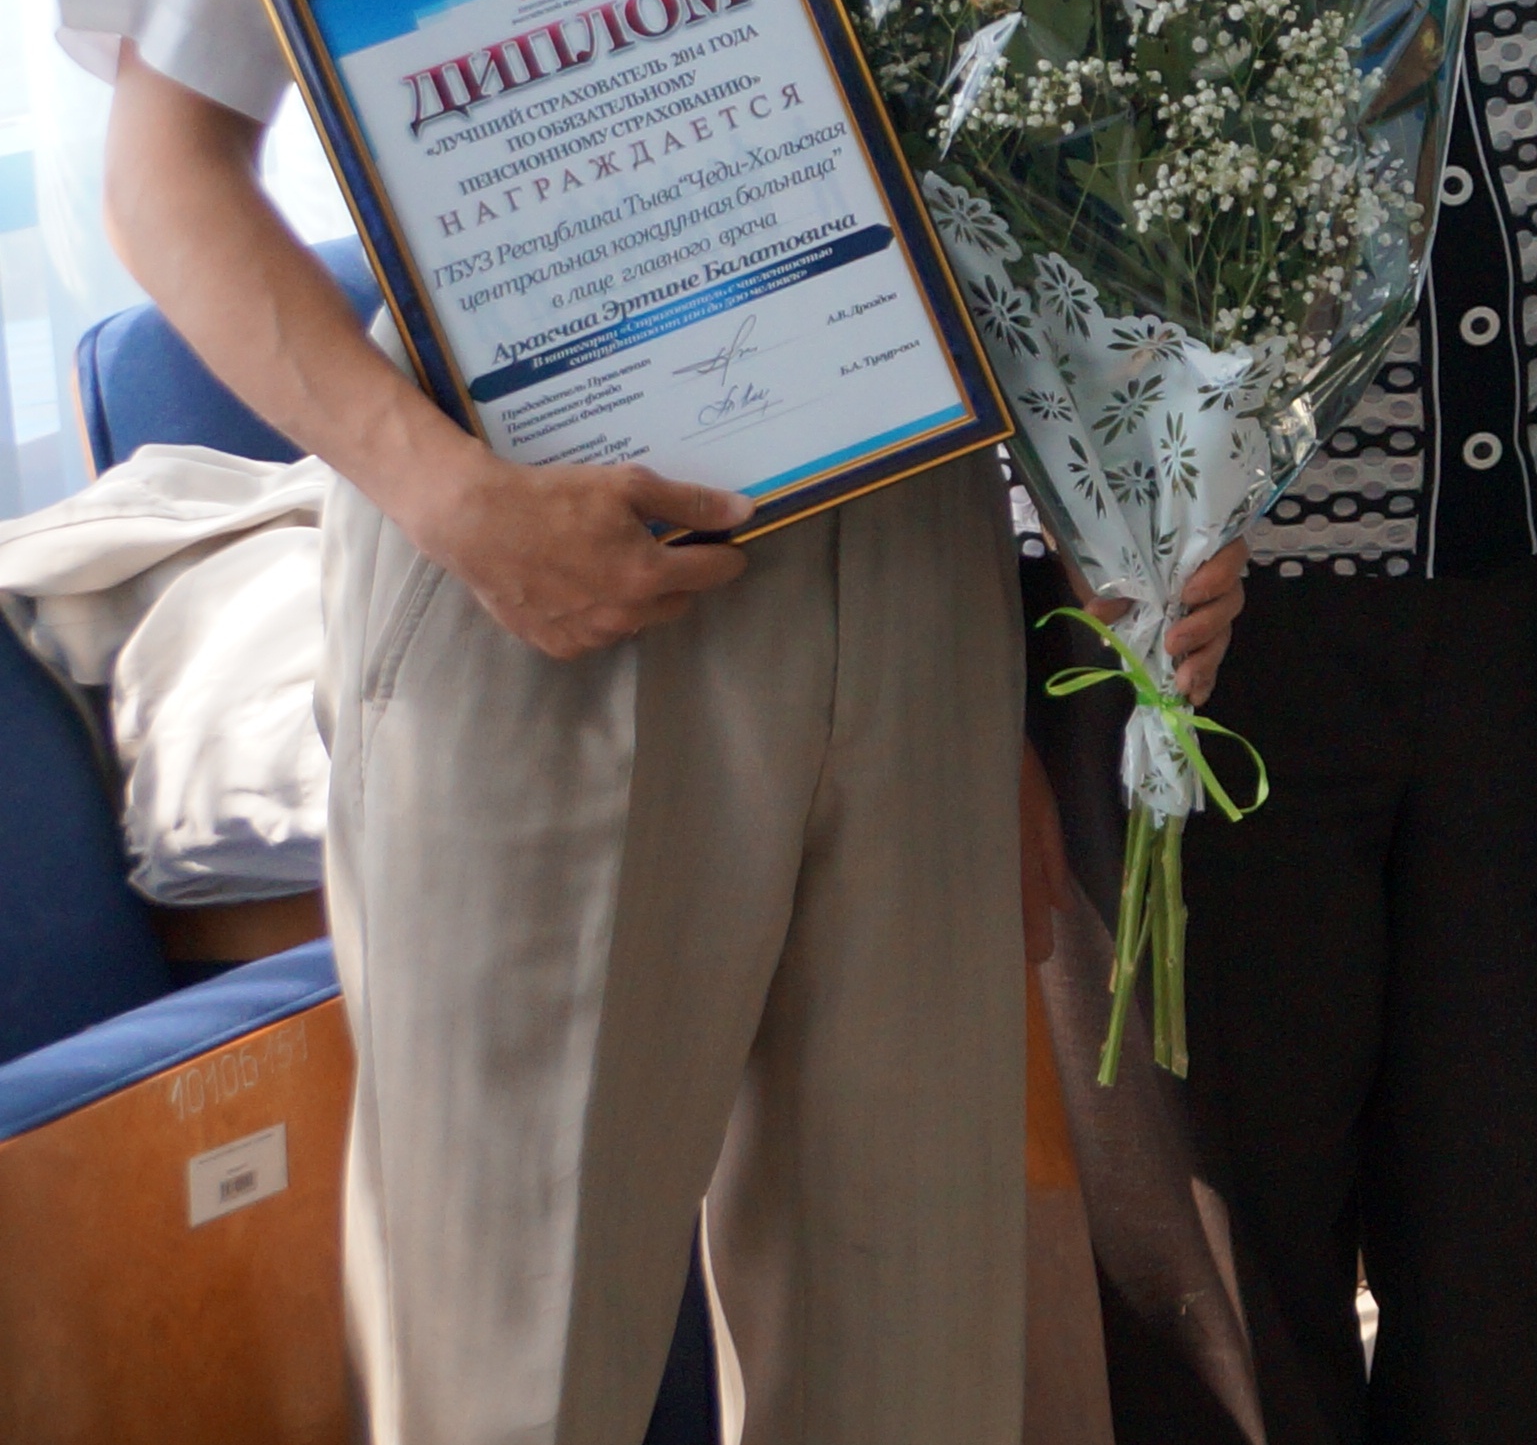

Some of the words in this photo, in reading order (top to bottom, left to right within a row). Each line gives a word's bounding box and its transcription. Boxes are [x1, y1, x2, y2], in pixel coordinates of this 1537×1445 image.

[423, 109, 525, 157] «ЛУЧШИЙ
[524, 57, 668, 119] СТРАХОВАТЕЛЬ
[669, 42, 706, 65] 2014
[707, 23, 759, 52] ГОДА
[458, 126, 619, 194] ПЕНСИОННОМУ
[614, 72, 762, 135] СТРАХОВАНИЮ»
[505, 130, 538, 152] ПО
[535, 71, 699, 140] ОБЯЗАТЕЛЬНОМУ
[438, 86, 802, 232] НАГРАЖДАЕТСЯ
[430, 252, 496, 288] ГБУЗ
[495, 205, 625, 266] Республики
[458, 245, 610, 312] центральная
[608, 195, 736, 256] кожуунная
[488, 311, 602, 366] Аракчаа
[600, 271, 703, 324] Эртине
[701, 212, 857, 280] Балатовича
[551, 296, 564, 308] в
[562, 274, 616, 305] лице
[620, 240, 712, 281] главного
[716, 212, 779, 247] врача
